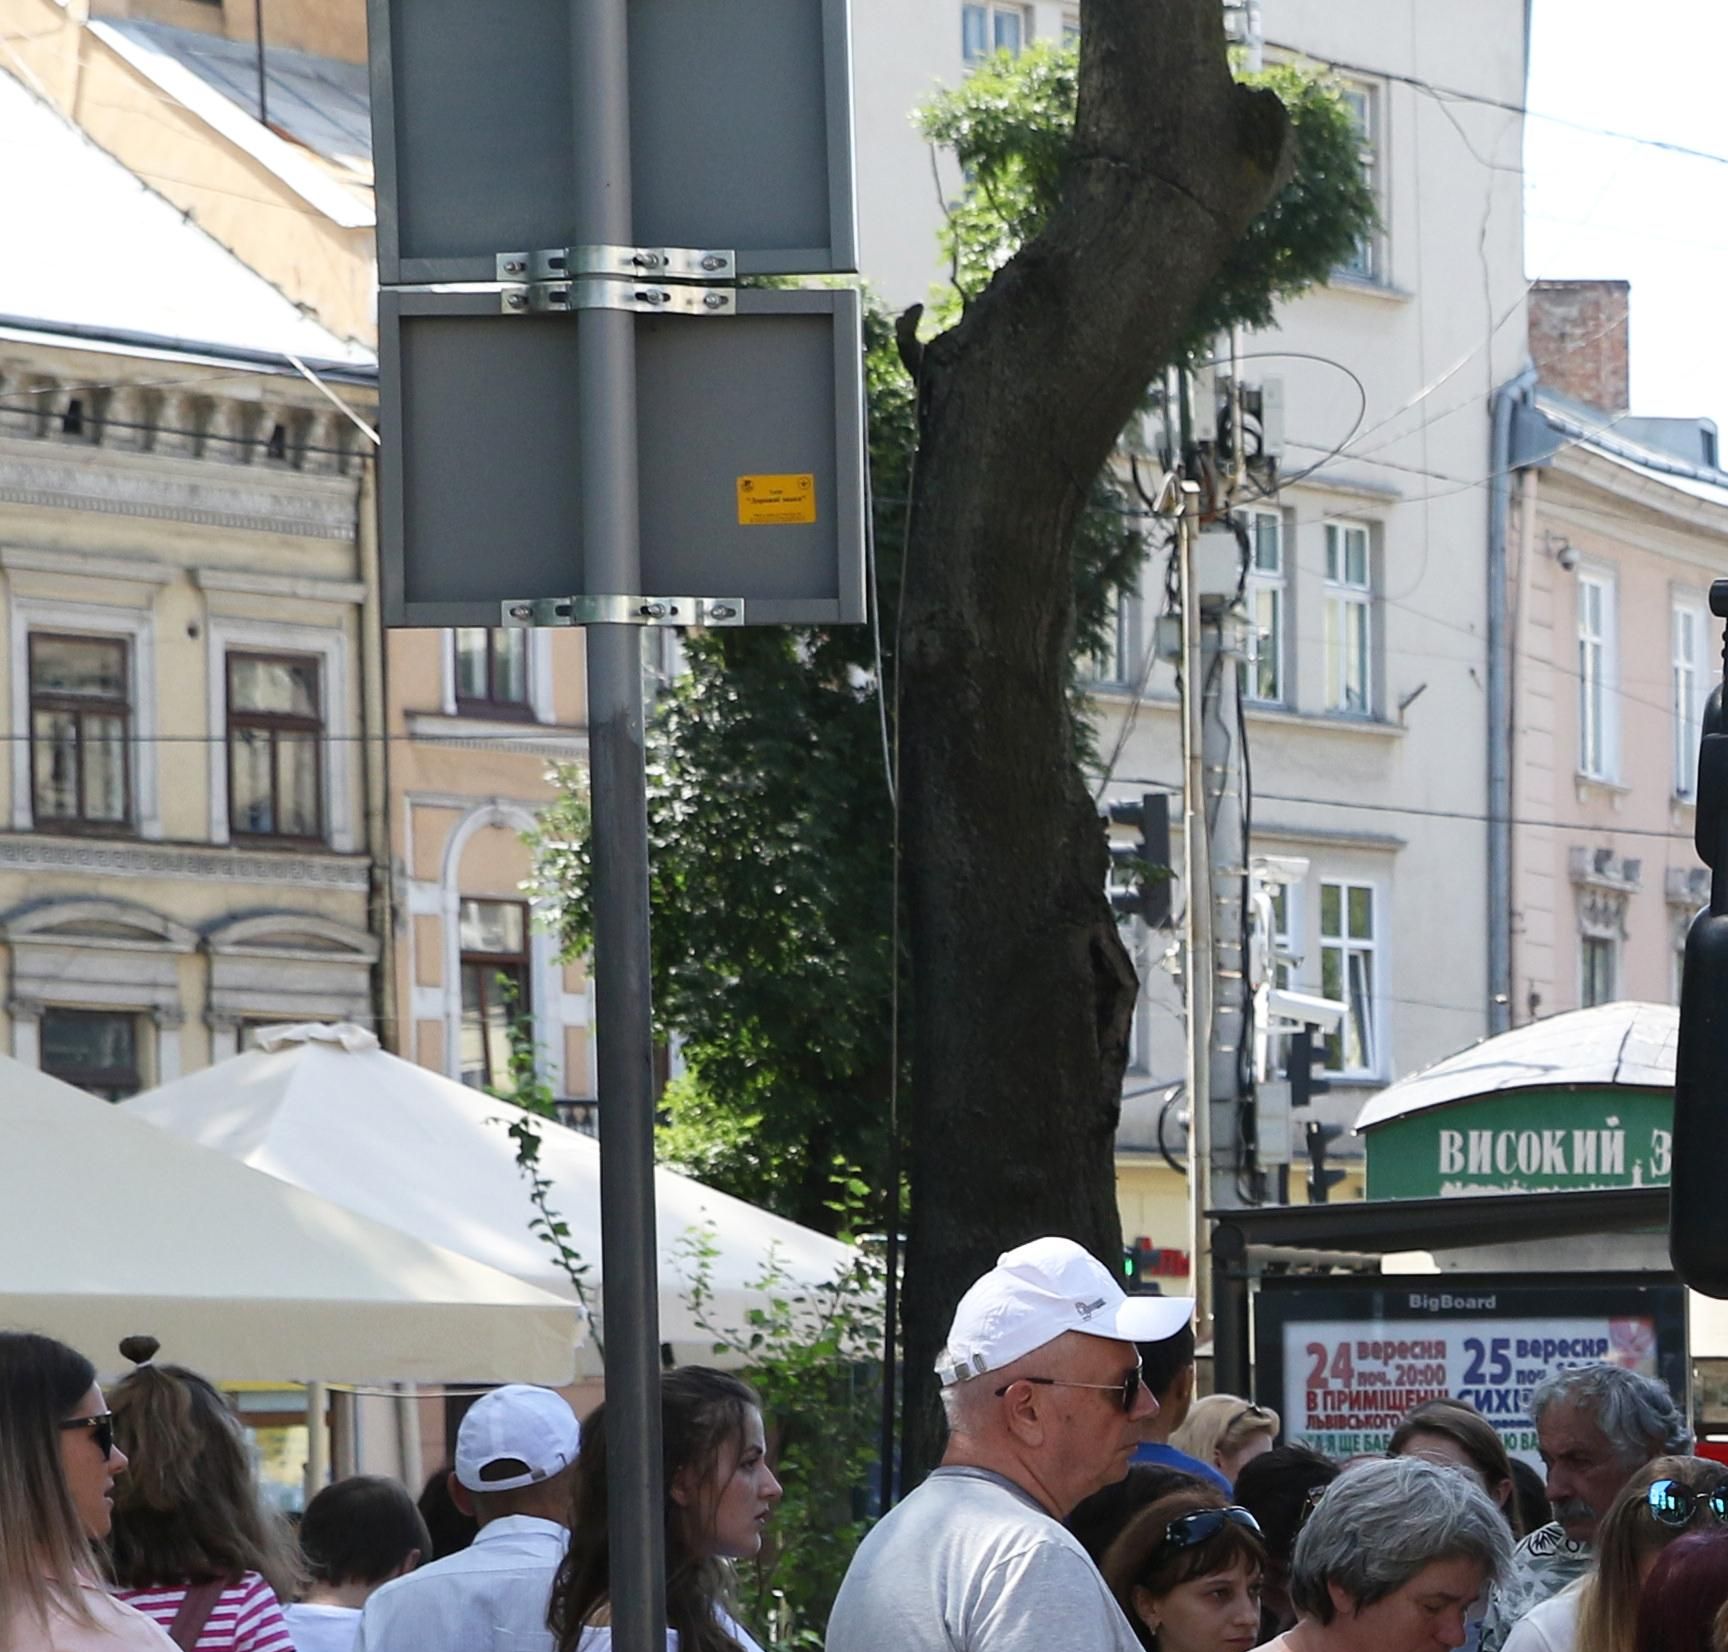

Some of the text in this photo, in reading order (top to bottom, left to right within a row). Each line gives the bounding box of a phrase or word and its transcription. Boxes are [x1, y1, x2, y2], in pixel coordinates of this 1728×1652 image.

[1438, 1115, 1672, 1178] ВИСОКИЙ З
[1408, 1293, 1497, 1312] BigBoard
[1305, 1340, 1447, 1390] 24 вересня
[1357, 1364, 1446, 1386] поч. 20:00
[1462, 1337, 1609, 1386] 25 вересня
[1306, 1391, 1318, 1412] В
